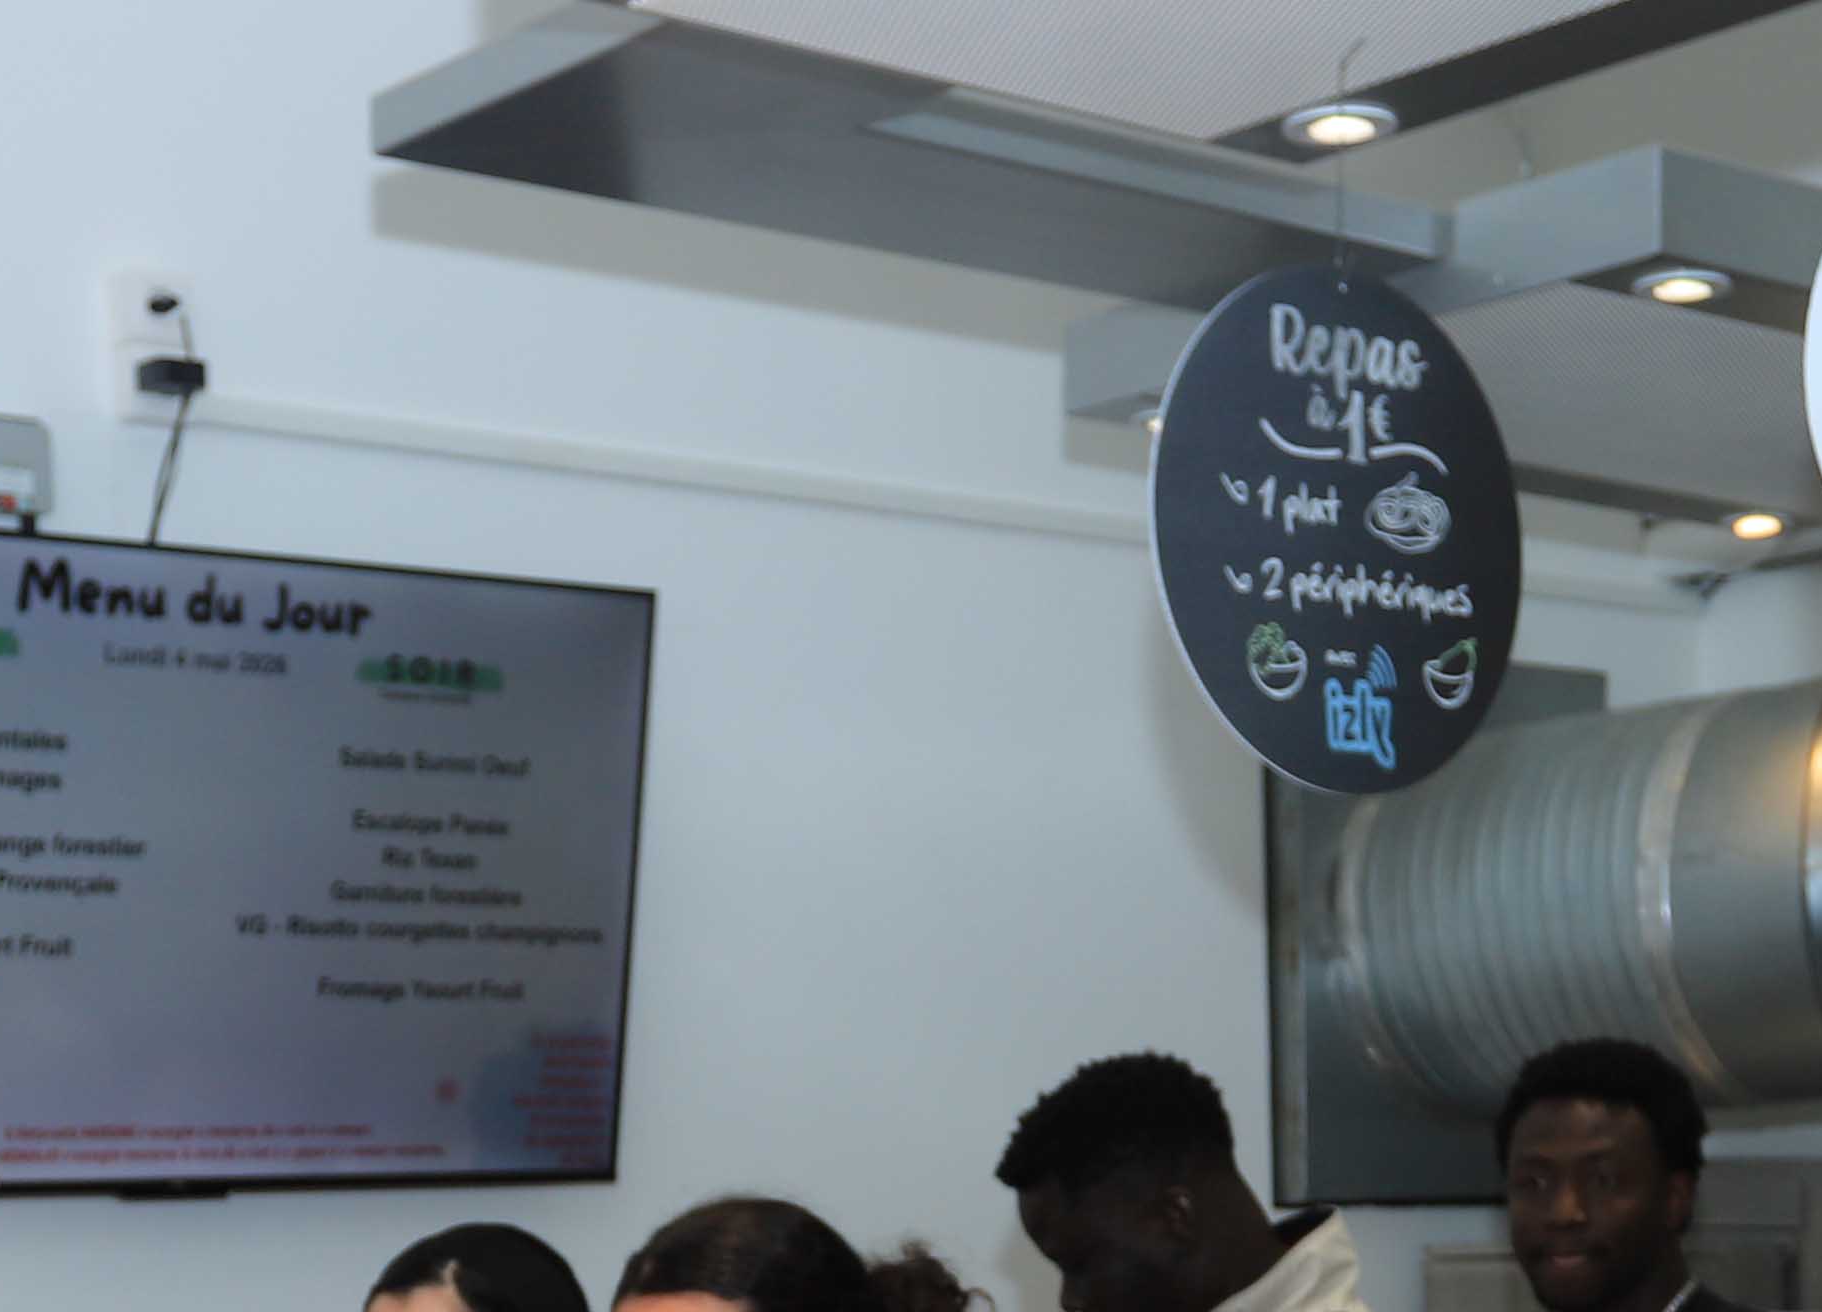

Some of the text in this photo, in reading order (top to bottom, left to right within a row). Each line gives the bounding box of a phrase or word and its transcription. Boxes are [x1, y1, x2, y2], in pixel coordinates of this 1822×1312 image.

[1269, 303, 1429, 400] Repas
[1256, 474, 1343, 534] 1 plat
[17, 556, 373, 635] Menu du Jour
[1260, 557, 1474, 623] 2 périphériques
[1324, 677, 1397, 769] izly
